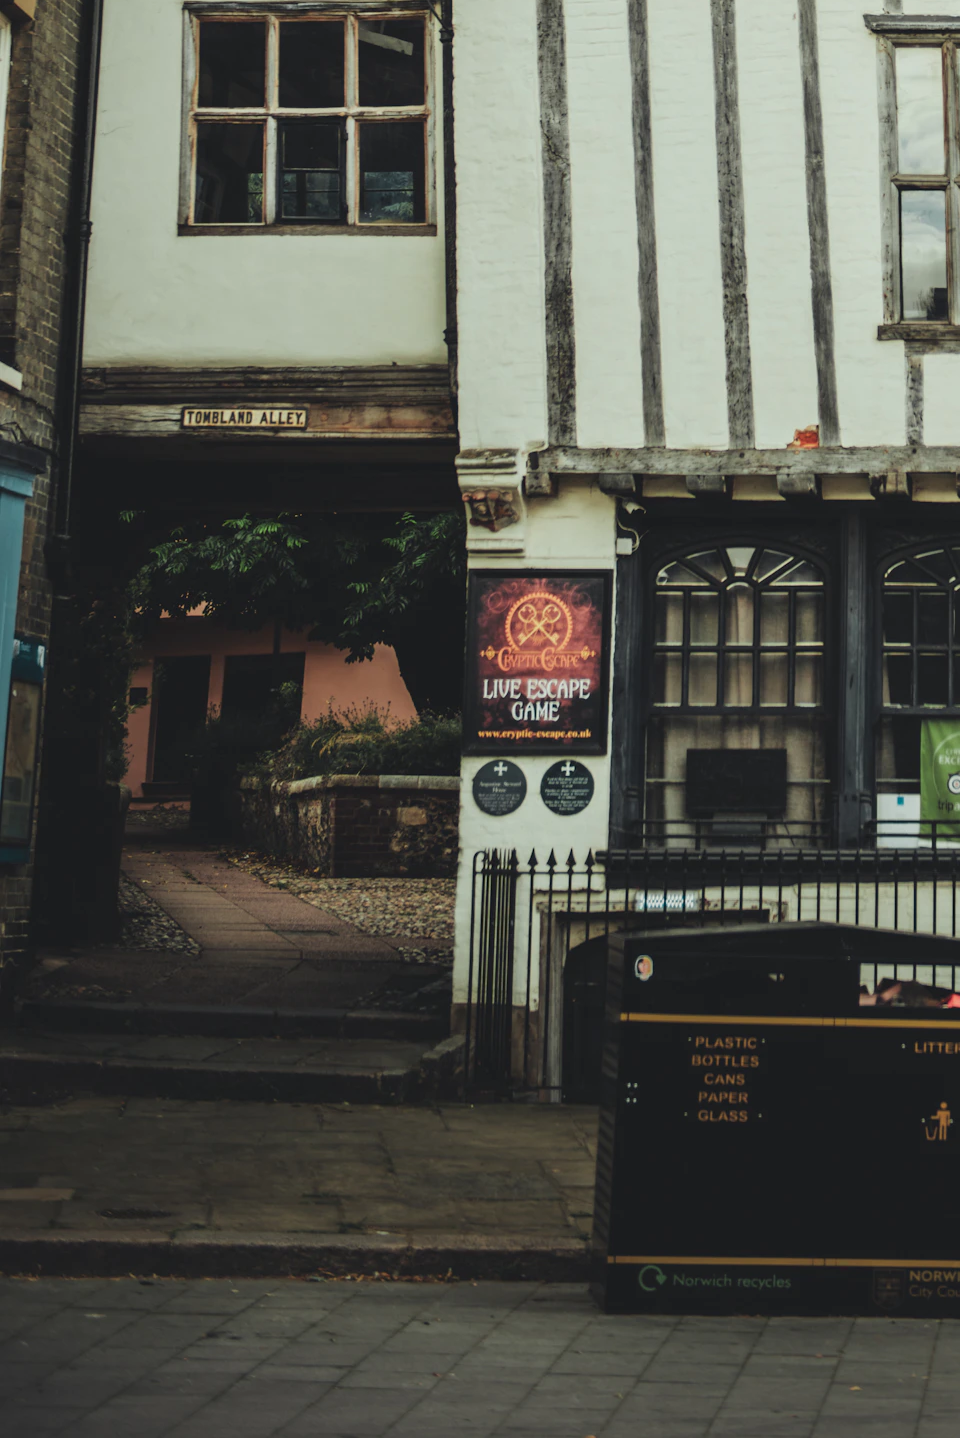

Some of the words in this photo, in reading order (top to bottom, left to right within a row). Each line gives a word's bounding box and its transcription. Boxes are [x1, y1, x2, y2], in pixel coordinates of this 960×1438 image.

[187, 411, 253, 424] TOMBLAND
[483, 678, 522, 699] LIVE
[526, 678, 591, 699] ESCAPE
[511, 701, 560, 722] GAME
[478, 728, 591, 740] www.cryptic-escape.co.uk
[695, 1035, 757, 1049] PLASTIC
[691, 1054, 760, 1068] BOTTLES
[704, 1072, 745, 1086] CANS
[698, 1091, 749, 1104] PAPER
[698, 1109, 748, 1122] GLASS
[673, 1273, 732, 1287] Norwich
[737, 1273, 792, 1290] recycles
[909, 1284, 933, 1301] City
